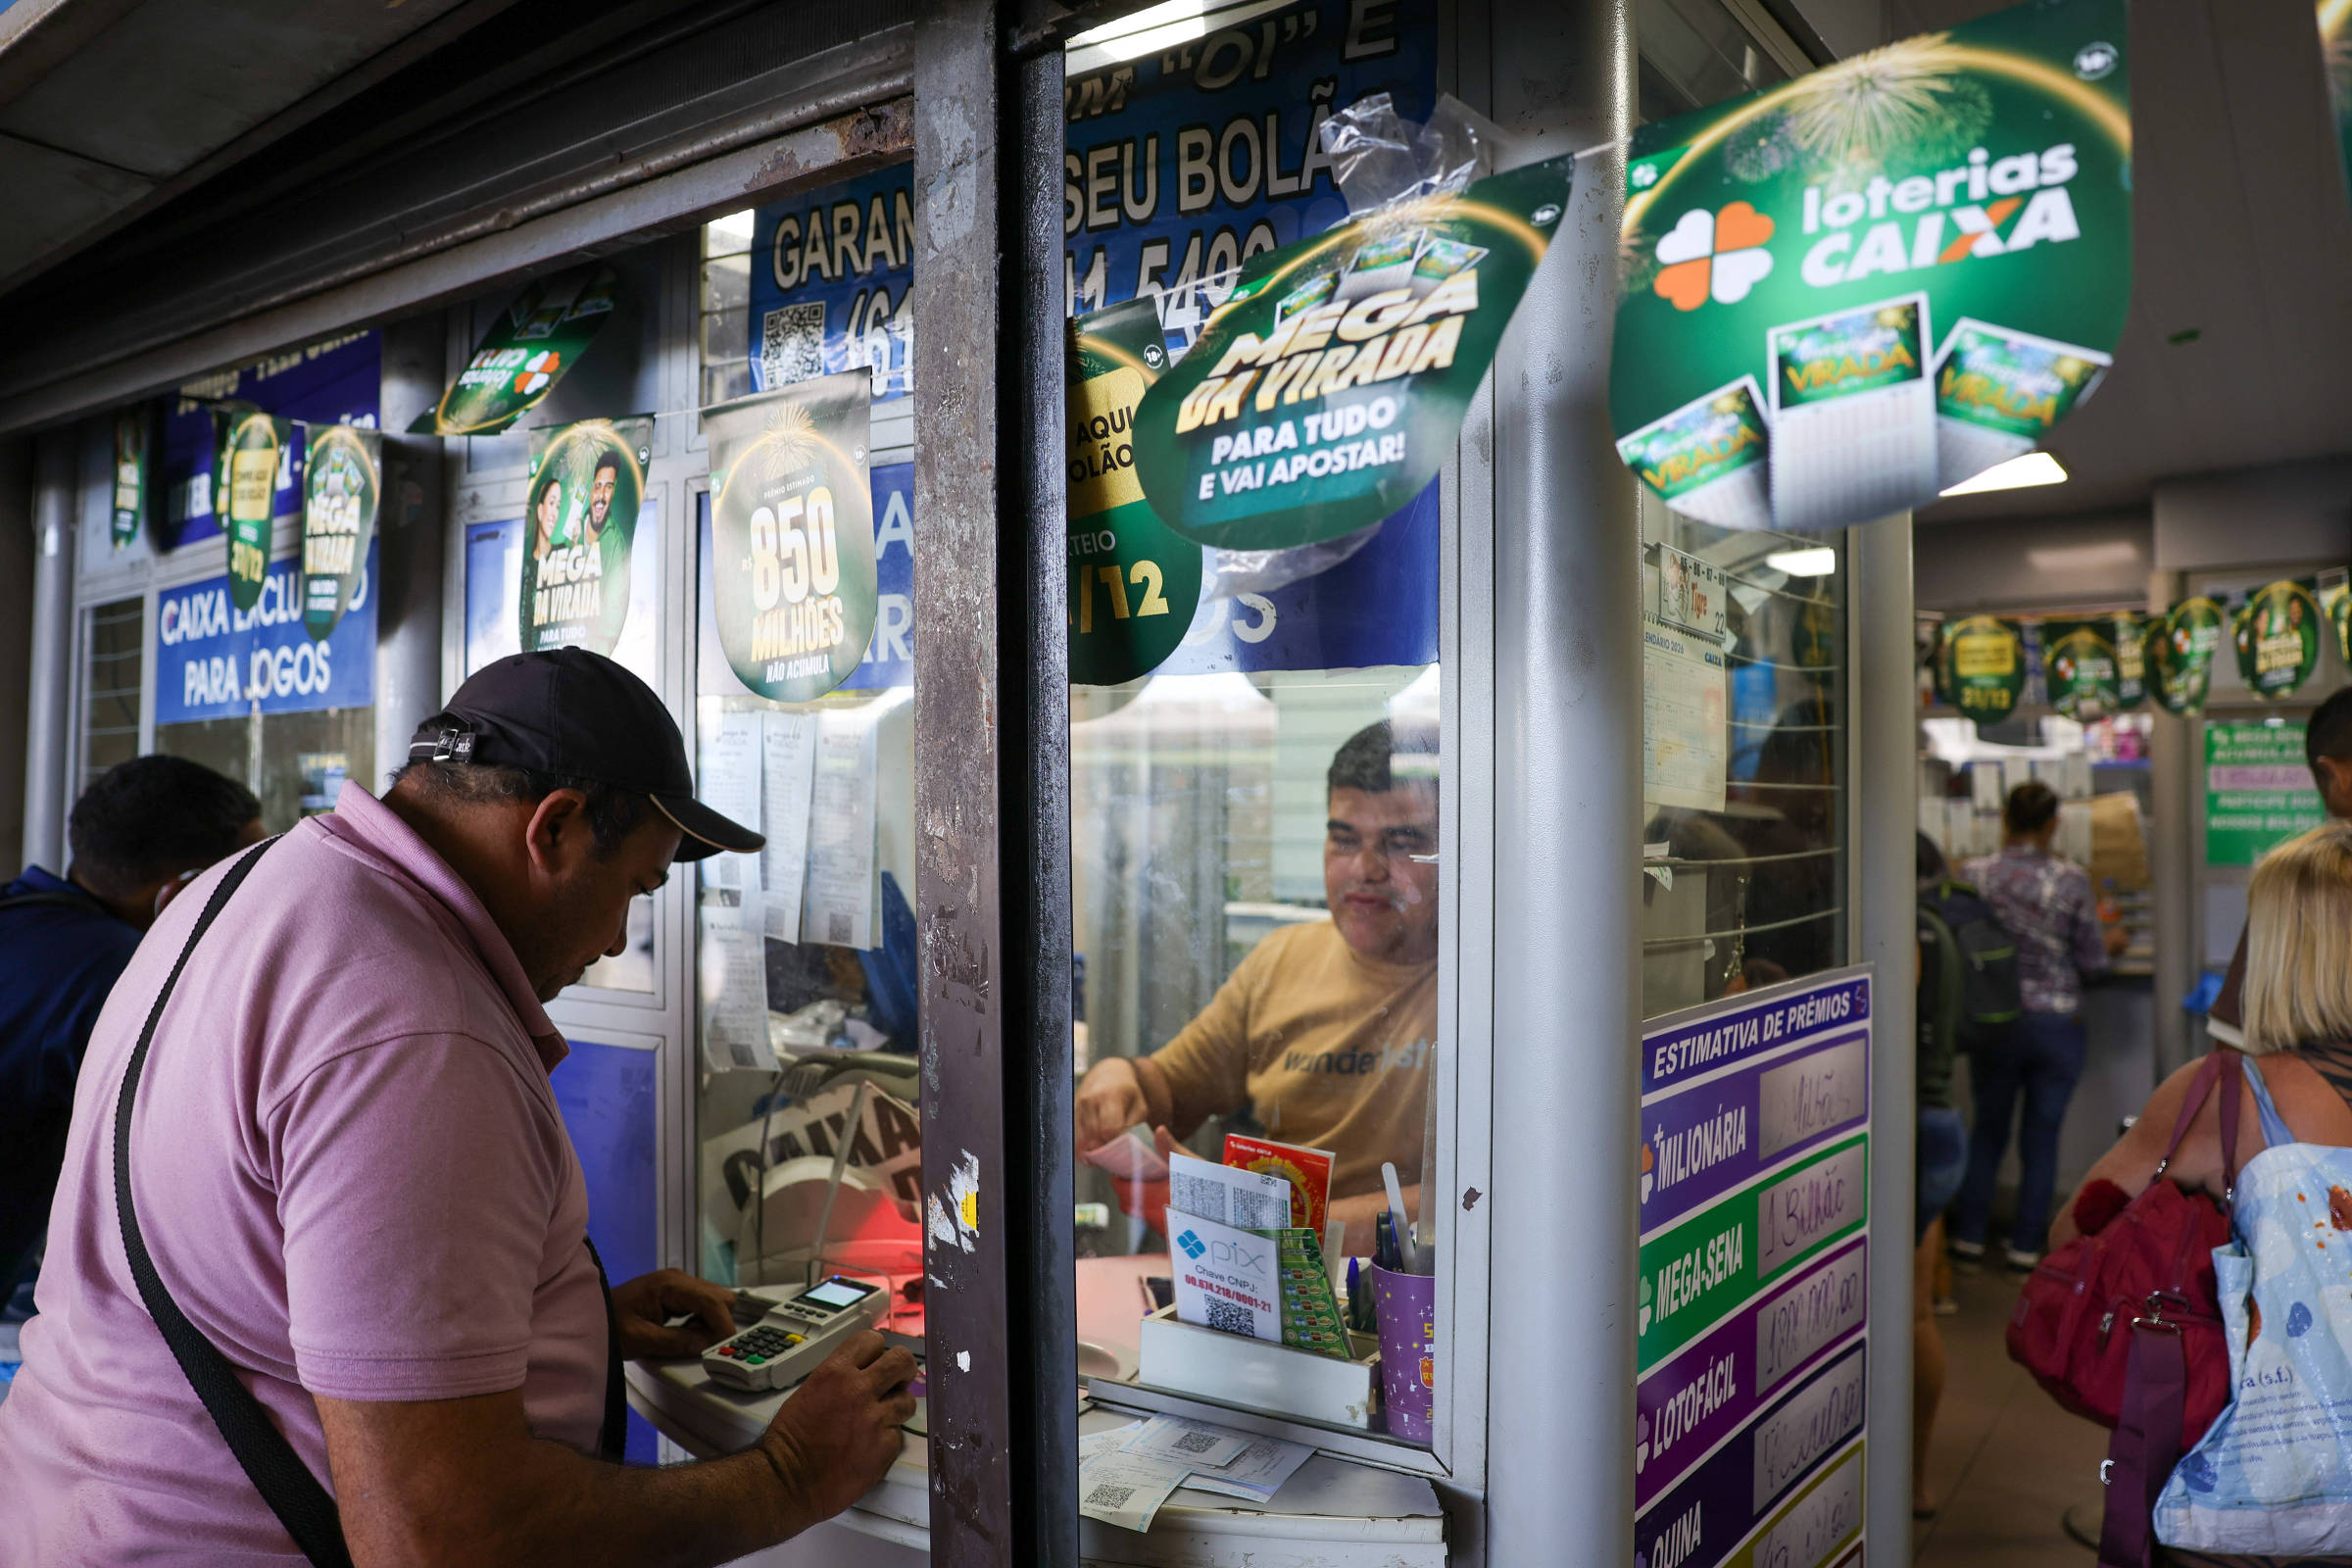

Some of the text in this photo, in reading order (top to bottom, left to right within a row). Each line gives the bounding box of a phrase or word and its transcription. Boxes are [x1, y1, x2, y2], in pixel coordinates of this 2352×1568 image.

[774, 192, 913, 289] GARAN
[1179, 82, 1341, 212] BOLÃ
[1803, 142, 2079, 234] loterias
[1801, 186, 2081, 287] CAIXA
[1207, 269, 1479, 378] MEGA
[1176, 315, 1465, 434] DA VIRADA
[1786, 343, 1915, 393] VIRADA
[1068, 443, 1135, 483] OLÃO
[1211, 396, 1398, 465] PARA TUDO
[1642, 425, 1763, 489] VIRADA
[1199, 431, 1406, 501] E VAI APOSTAR!
[536, 541, 603, 589] MEGA
[751, 486, 840, 611] 850
[161, 589, 229, 646] CAIXA
[751, 596, 844, 662] MILHÕES
[1068, 560, 1170, 633] /12
[1691, 582, 1707, 619] Tigre
[1715, 612, 1725, 635] 22
[184, 640, 331, 707] PARA JOGOS
[765, 655, 830, 683] NÃO ACUMULA
[1705, 652, 1722, 666] CAIXA
[1654, 991, 1850, 1079] ESTIMATIVA DE PRÊMIOS
[1196, 1265, 1259, 1294] Chave CNPJ:
[1211, 1241, 1266, 1274] pix
[1656, 1223, 1742, 1323] MEGA-SENA
[1653, 1352, 1736, 1460] LOTOFÁCIL
[1652, 1499, 1701, 1568] QUINA
